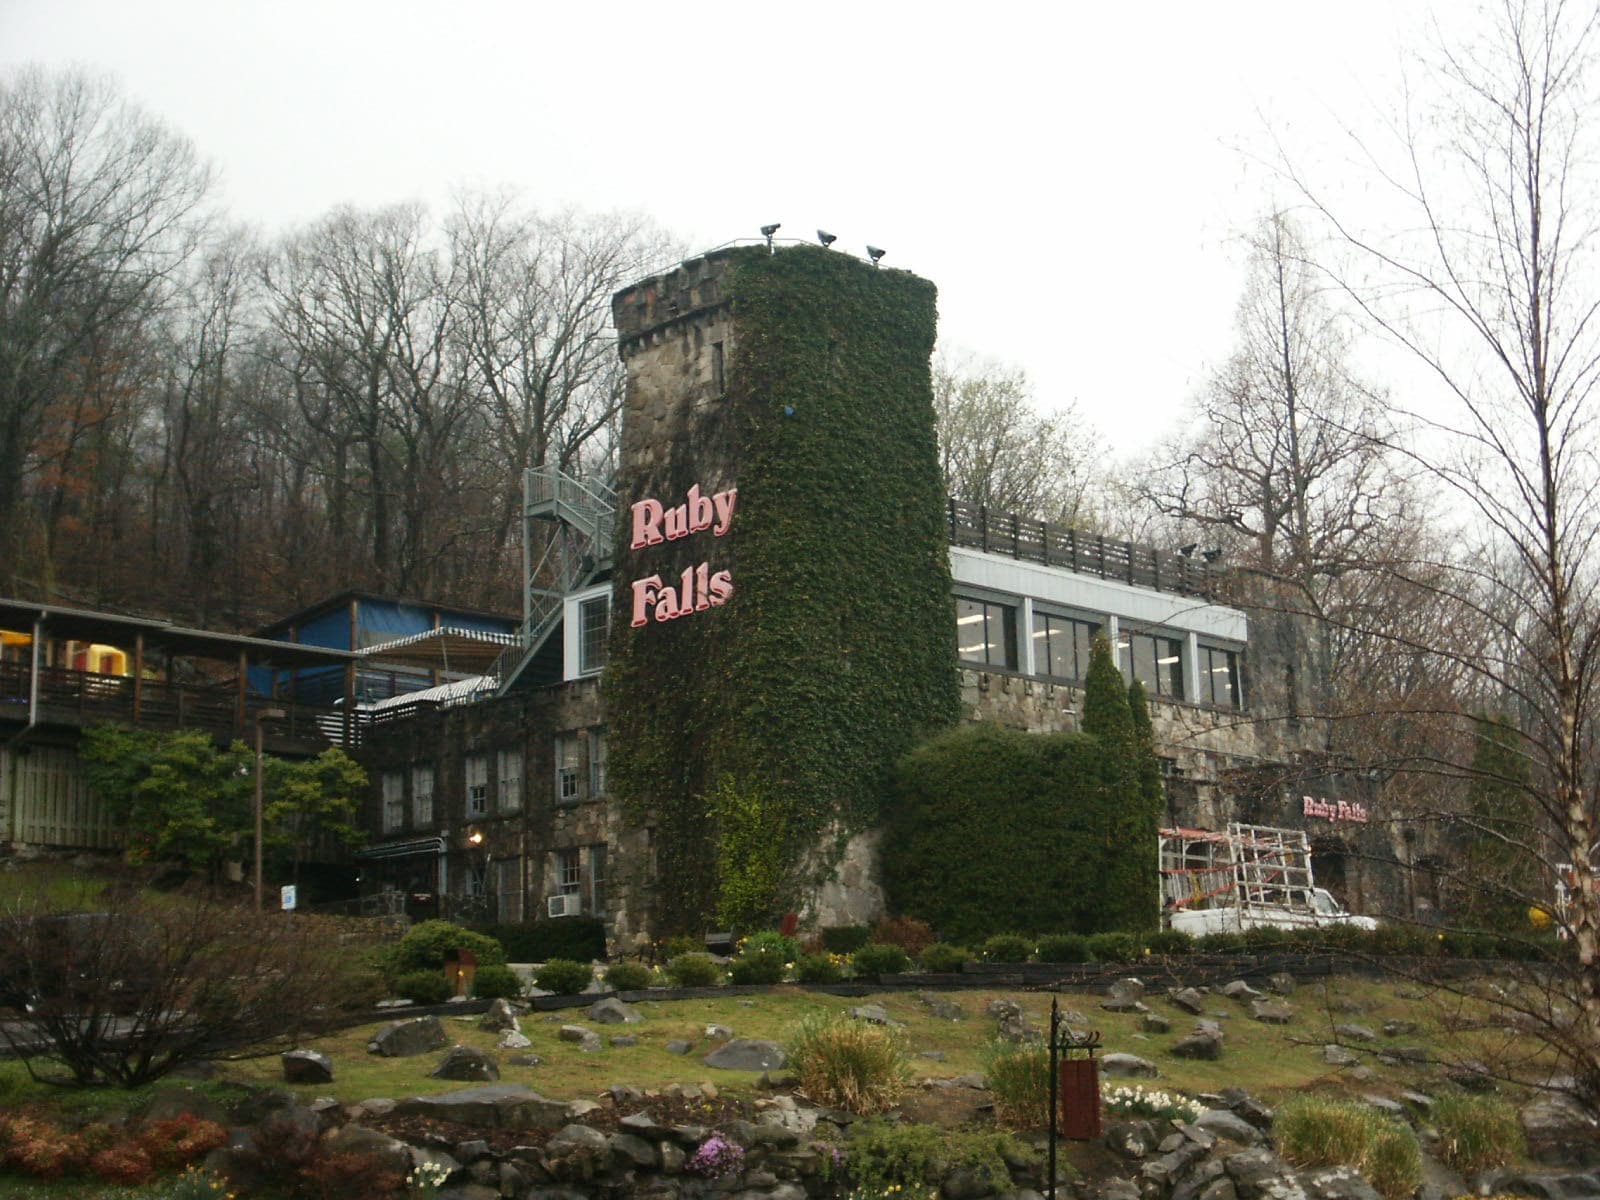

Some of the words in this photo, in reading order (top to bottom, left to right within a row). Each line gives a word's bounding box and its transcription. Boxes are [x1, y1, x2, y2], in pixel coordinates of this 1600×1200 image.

[631, 483, 737, 550] Ruby
[631, 562, 734, 627] Falls
[1303, 796, 1337, 822] Ruby
[1337, 801, 1367, 823] Falls
